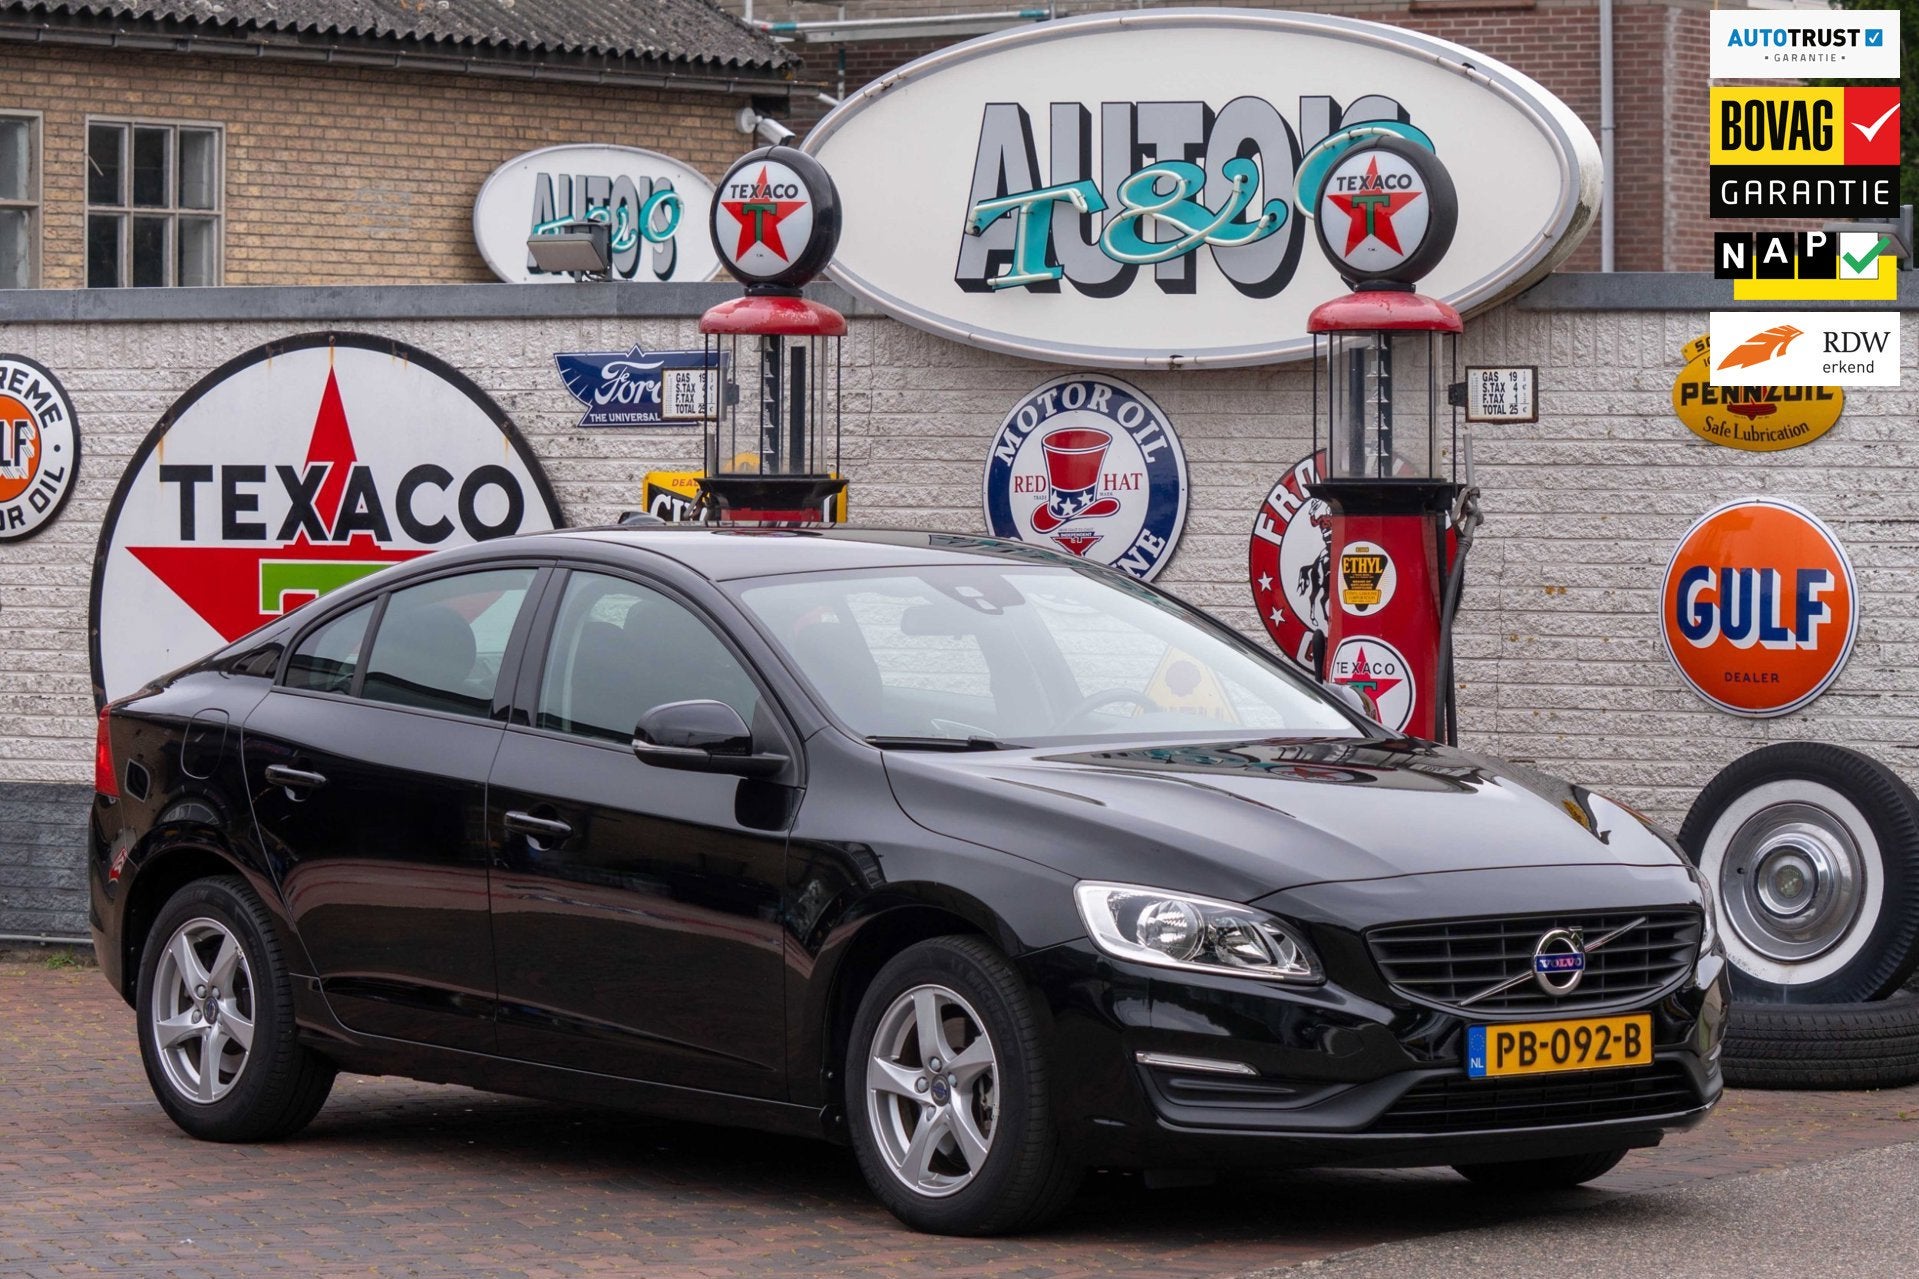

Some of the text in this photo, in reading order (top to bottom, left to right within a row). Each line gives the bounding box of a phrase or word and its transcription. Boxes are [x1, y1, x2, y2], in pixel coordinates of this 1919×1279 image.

[1336, 174, 1412, 191] TEXACO
[730, 184, 798, 199] TEXACO
[954, 94, 1411, 299] AUTO'
[676, 372, 690, 383] GAS
[1482, 371, 1499, 382] GAS
[1508, 371, 1518, 382] 19
[675, 383, 696, 393] S.TAX
[1482, 382, 1506, 393] S.TAX
[1512, 382, 1518, 393] 4
[1482, 393, 1505, 404] F.TAX
[675, 404, 696, 414] TOTAL
[1482, 404, 1507, 415] TOTAL
[1509, 404, 1519, 415] 25
[589, 413, 661, 423] THE UNIVERSAL
[994, 383, 1168, 467] MOTOR OIL
[1702, 415, 1810, 442] Safe Lubrication
[28, 466, 65, 514] OIL
[1014, 473, 1143, 494] RED HAT
[159, 463, 525, 544] TEXACO
[1115, 528, 1166, 578] NE
[1343, 557, 1383, 574] ETHYL
[1676, 565, 1835, 650] GULF
[1336, 661, 1396, 675] TEXACO
[1724, 672, 1780, 684] DEALER
[1540, 957, 1582, 969] VOLVO
[1470, 1022, 1642, 1069] NL PB-092-B
